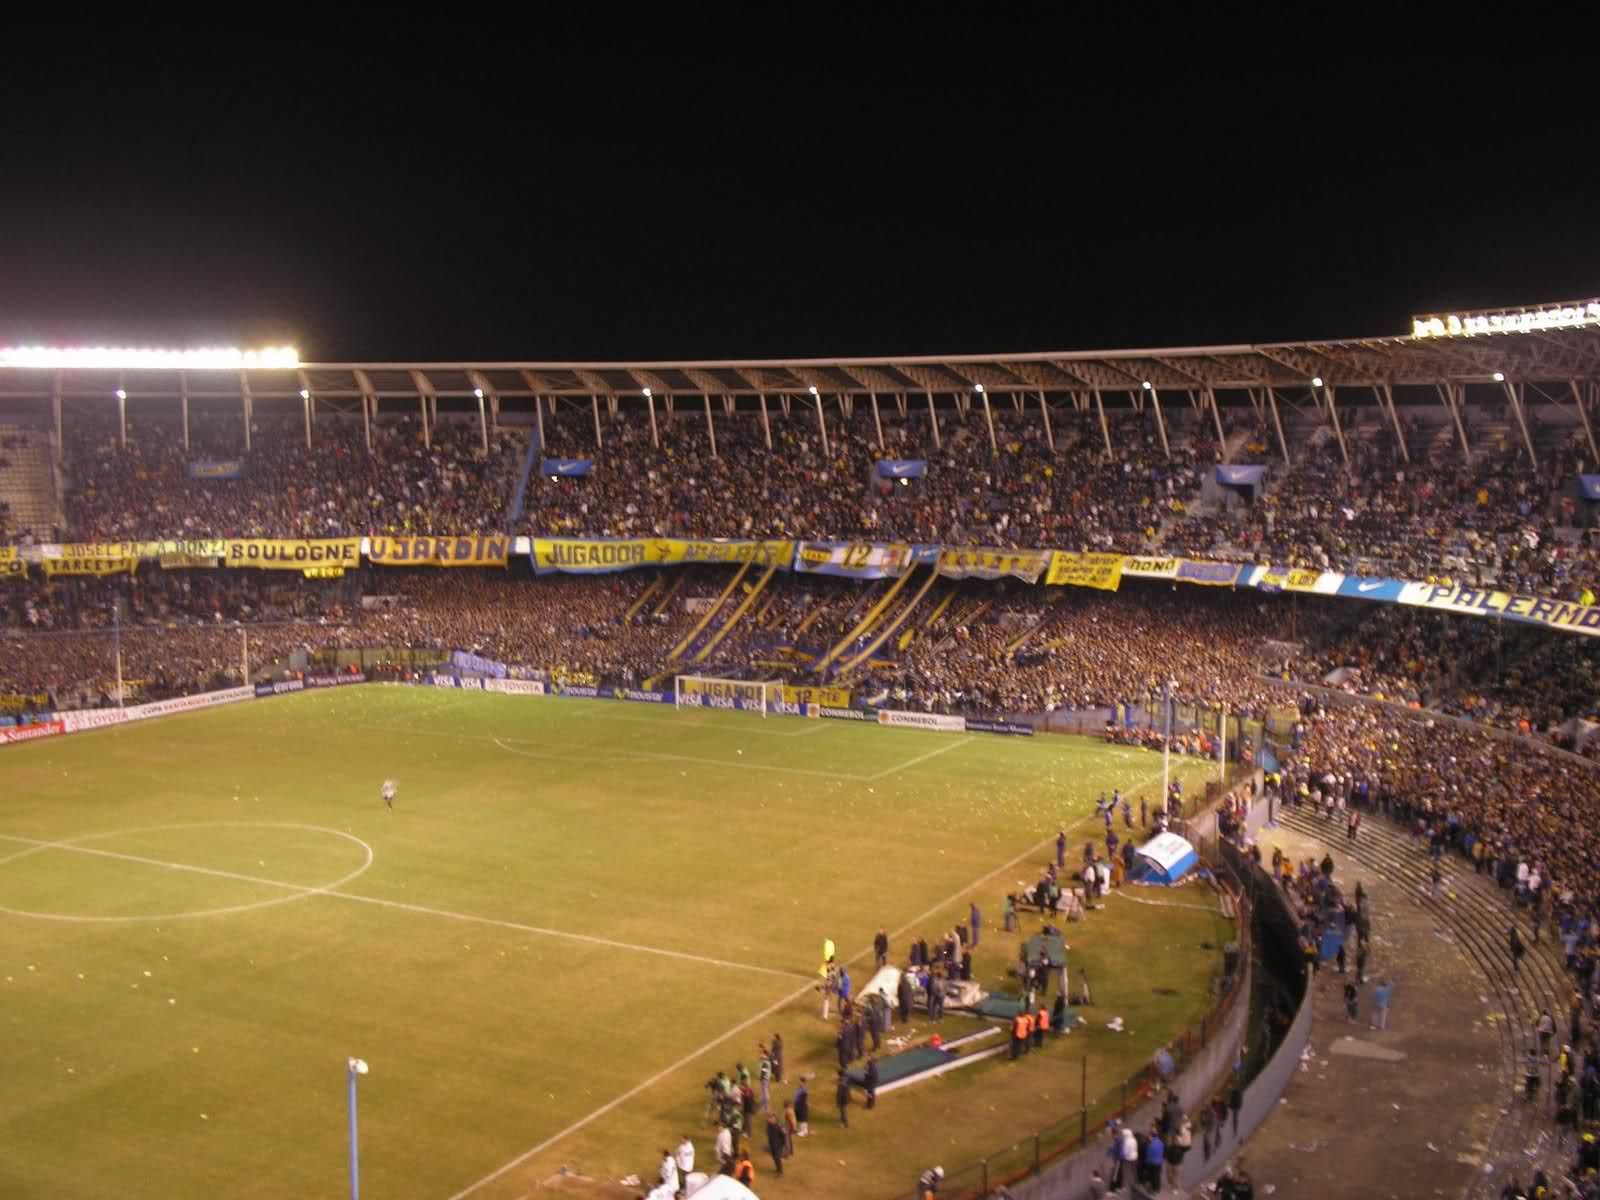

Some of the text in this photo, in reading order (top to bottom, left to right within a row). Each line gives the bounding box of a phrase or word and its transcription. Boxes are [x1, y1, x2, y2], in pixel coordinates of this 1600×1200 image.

[231, 543, 355, 562] BOULOGNE
[545, 543, 646, 565] JUGADOR
[843, 542, 873, 568] 12
[1427, 582, 1600, 628] PALERMO
[432, 674, 456, 688] VISA
[459, 677, 483, 690] VISA
[505, 681, 541, 692] TOYOTA
[679, 693, 703, 707] VISA
[708, 696, 735, 710] VISA
[86, 710, 129, 728] TOYOTA
[820, 706, 864, 720] CONMEBOL
[891, 713, 938, 726] CONMEBOL
[7, 721, 62, 741] Santander
